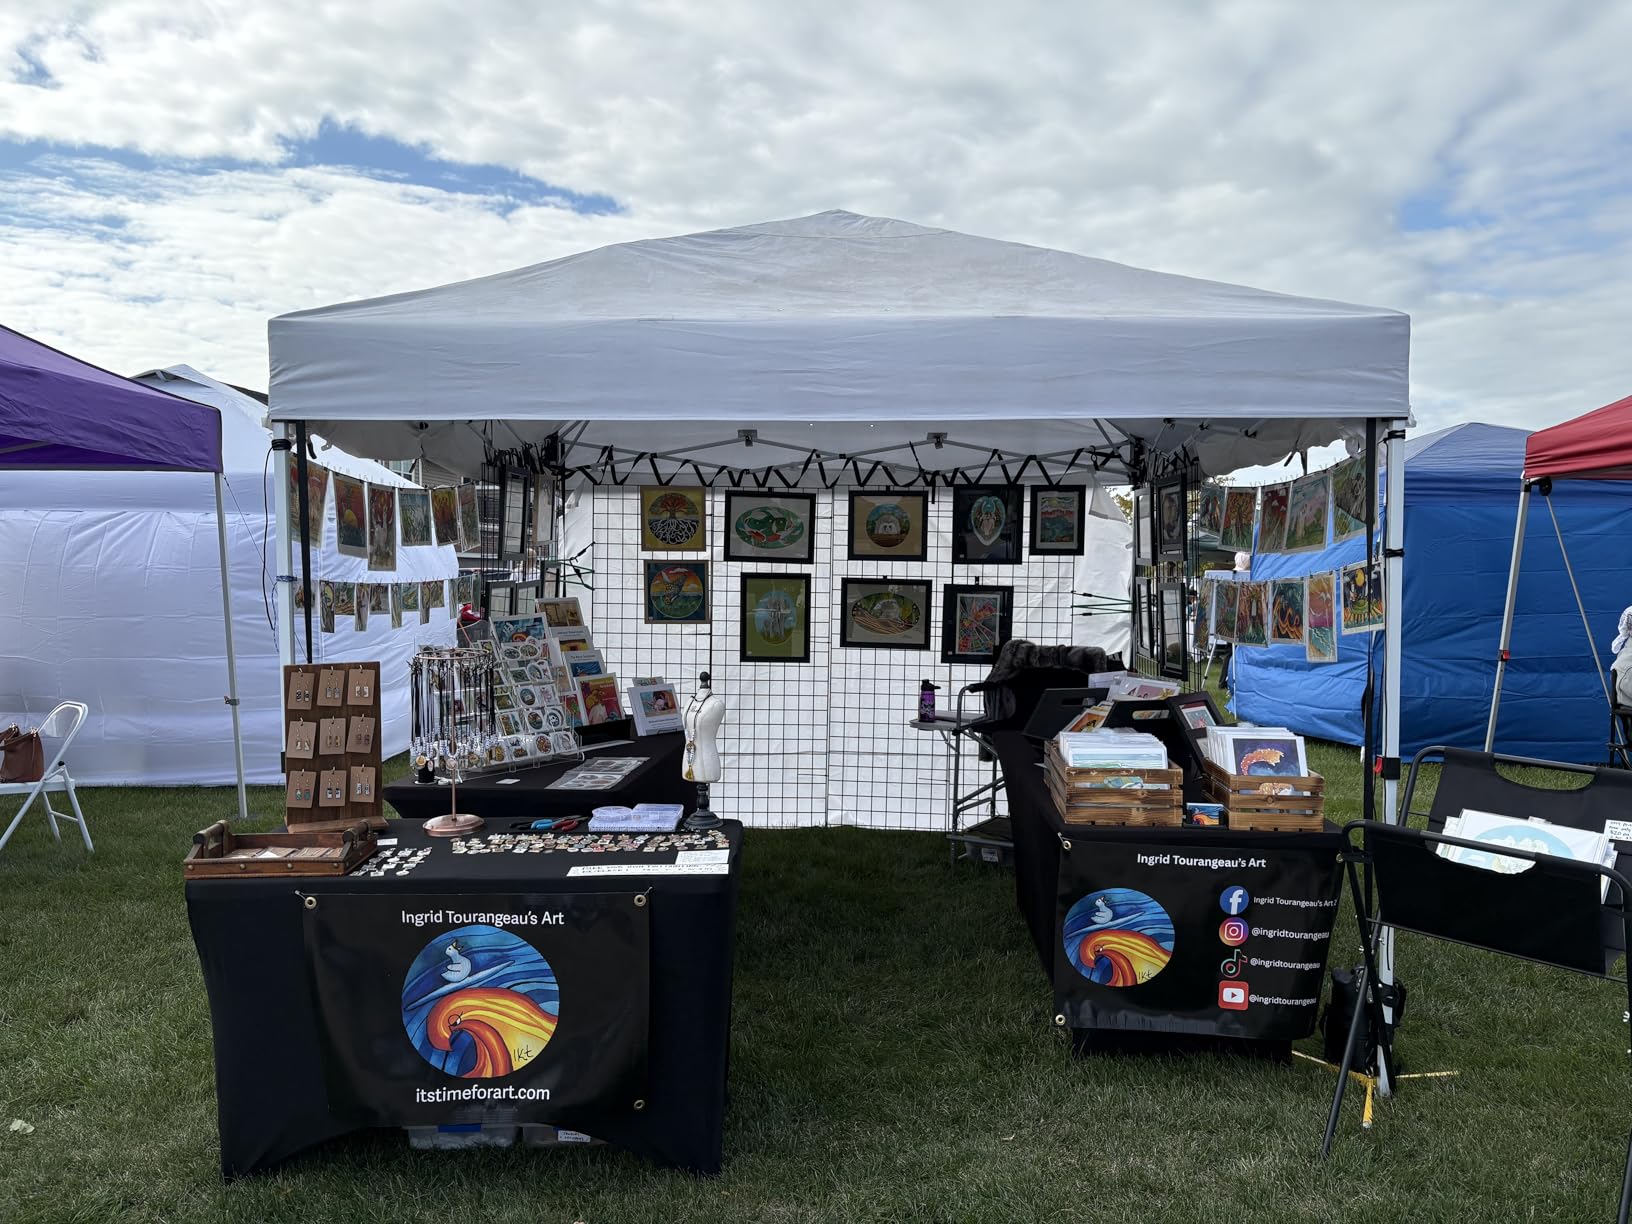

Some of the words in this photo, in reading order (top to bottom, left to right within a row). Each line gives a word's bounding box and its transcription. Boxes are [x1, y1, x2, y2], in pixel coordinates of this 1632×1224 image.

[1137, 853, 1170, 866] Ingrid
[1172, 855, 1246, 870] Tourangeau's
[1247, 858, 1267, 868] Art
[1253, 896, 1274, 905] Ingrid
[1275, 897, 1323, 908] Tourangeau's
[401, 910, 443, 927] Ingrid
[446, 910, 538, 928] Tourangeau's
[541, 911, 565, 925] Art
[1251, 927, 1330, 942] @ingridtourangeau
[1250, 957, 1320, 971] @ingridtourangeau
[1249, 994, 1317, 1007] @ingridtourangeau
[416, 1084, 550, 1103] itstimeforart.com
